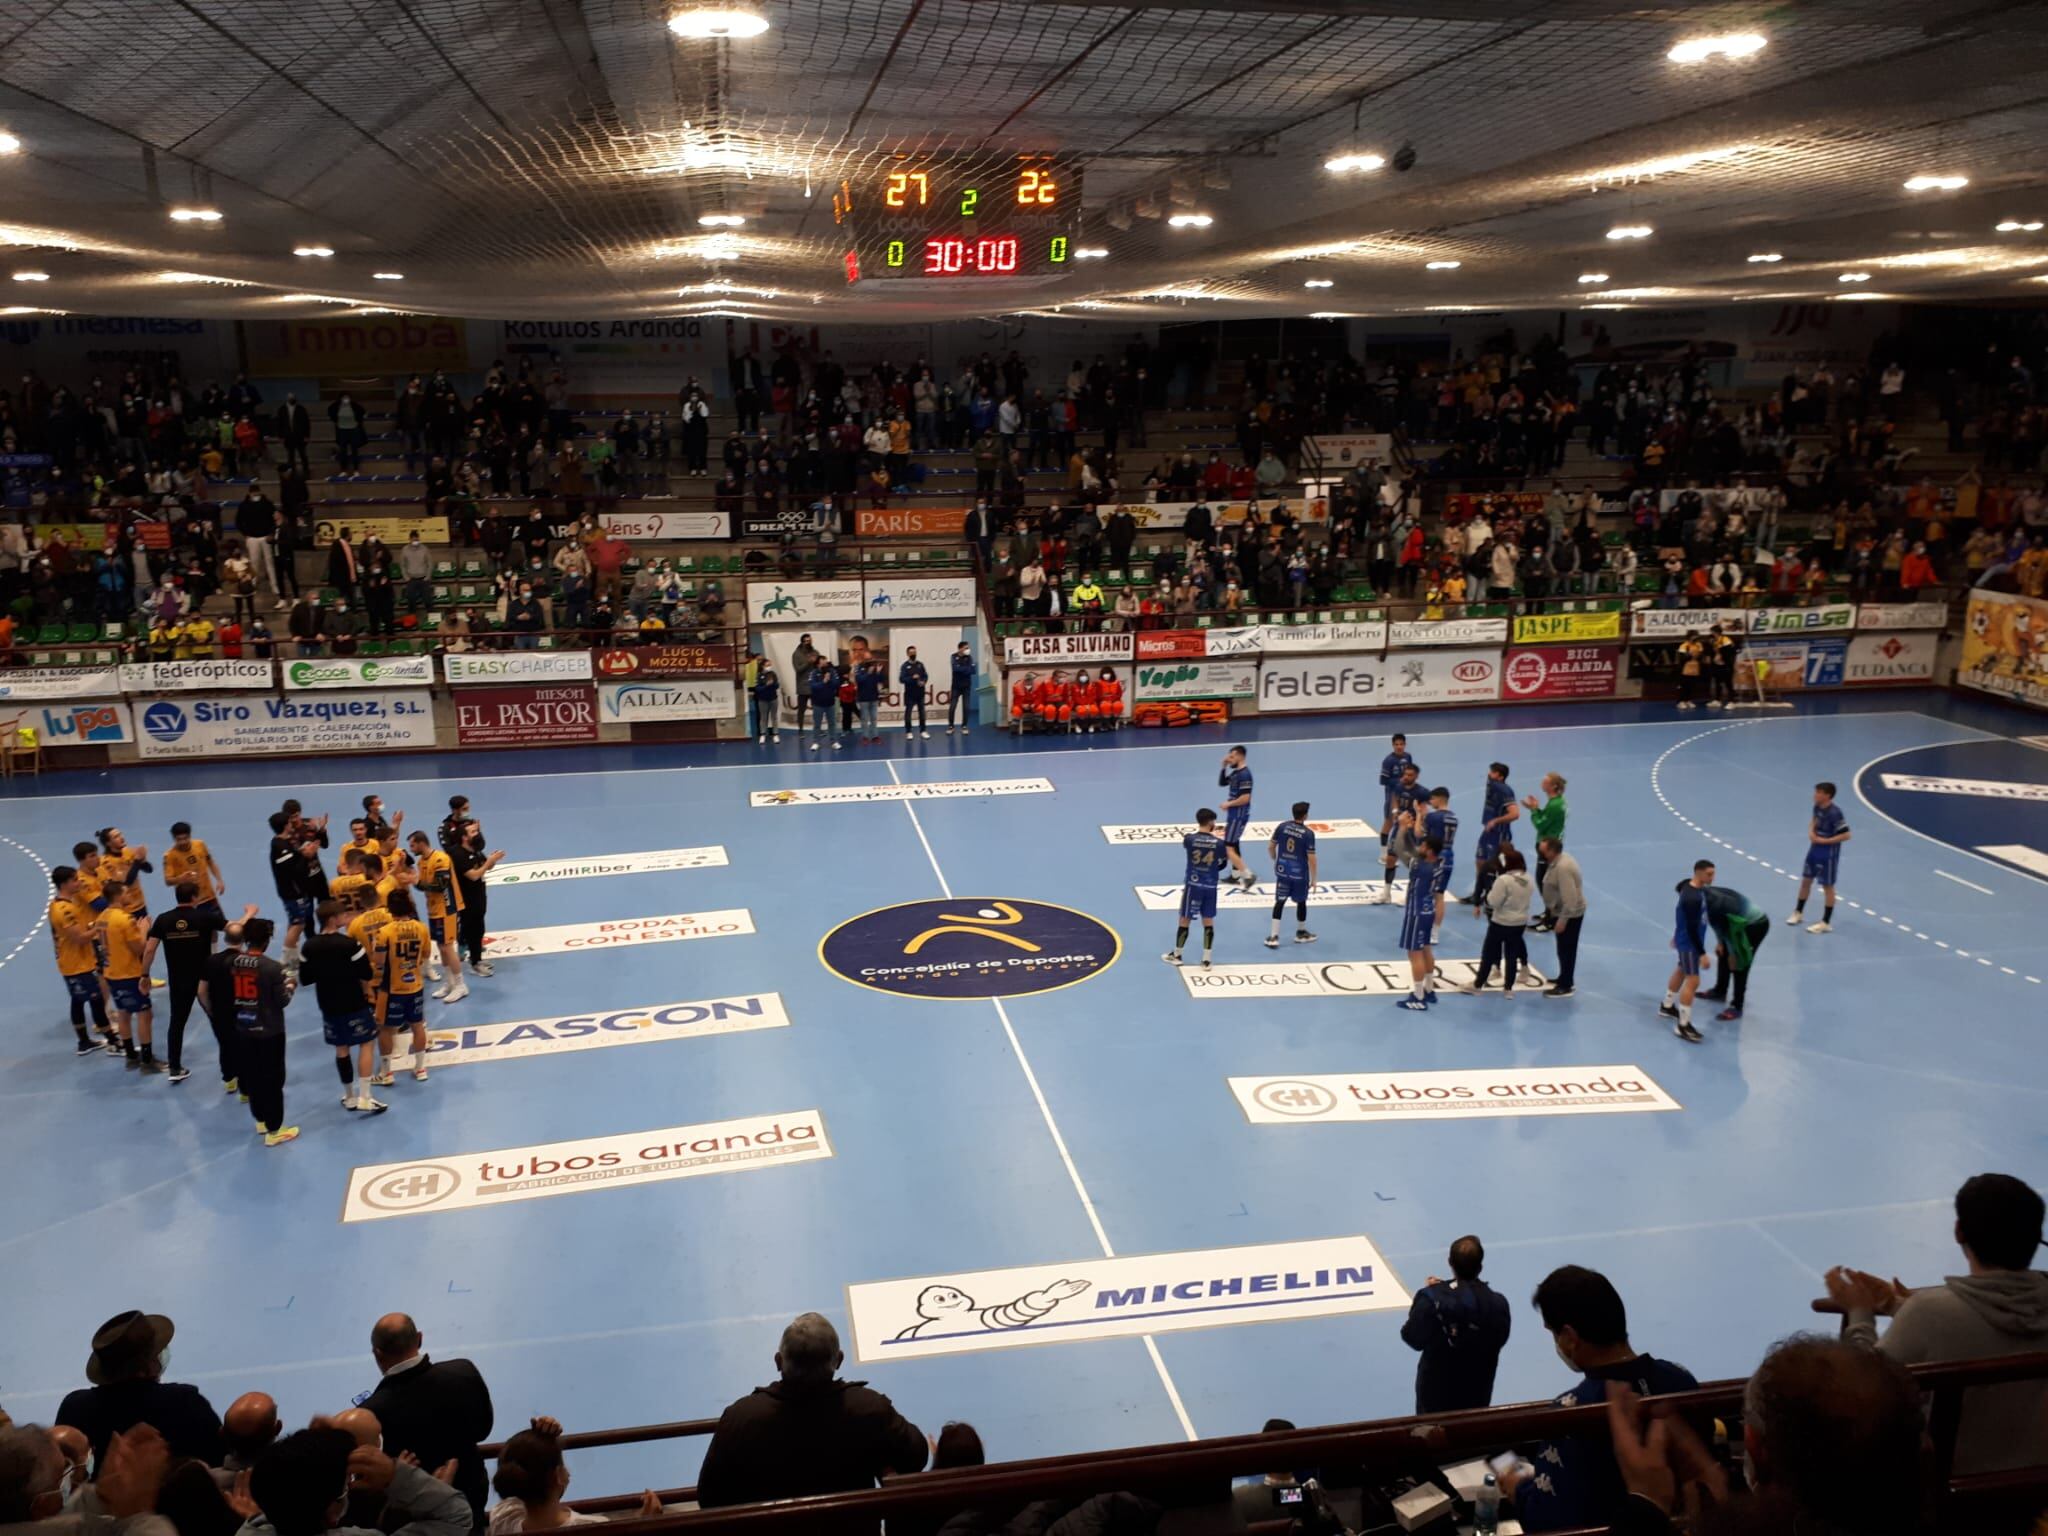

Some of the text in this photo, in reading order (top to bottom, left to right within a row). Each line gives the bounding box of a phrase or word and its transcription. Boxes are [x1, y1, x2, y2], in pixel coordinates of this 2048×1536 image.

[887, 173, 927, 206] 27
[961, 189, 977, 215] 2
[888, 241, 903, 266] 0
[925, 239, 1016, 272] 30:00
[1051, 237, 1066, 262] 0
[860, 511, 923, 532] PARÍS
[1516, 616, 1574, 641] JASPE
[1772, 609, 1850, 629] imesa
[1267, 627, 1381, 641] Carmelo Rodero
[662, 648, 705, 657] LUCIO
[1022, 635, 1131, 655] CASA SILVIANO
[1210, 637, 1261, 652] AJAX
[1567, 648, 1601, 660] BICI
[152, 660, 267, 679] federópticos
[468, 658, 588, 675] EASYCHARGER
[1460, 665, 1487, 678] KIA
[1549, 661, 1614, 673] ARANDA
[194, 702, 250, 722] Siro
[459, 701, 595, 728] EL PASTOR
[42, 706, 120, 740] lupa
[214, 735, 288, 746] MOBILIARIO
[293, 735, 308, 743] DE
[314, 733, 360, 742] COCINA
[376, 731, 411, 740] BAÑO
[1119, 826, 1197, 835] prado
[1286, 838, 1296, 853] 6
[1191, 850, 1215, 867] 34
[529, 863, 633, 880] MultiRiber
[600, 916, 696, 932] BODAS
[564, 923, 740, 947] CON ESTILO
[860, 954, 1095, 976] Concejalía de Deportes
[235, 974, 257, 999] 16
[1190, 972, 1312, 987] BODEGAS
[1347, 1077, 1646, 1100] tubos aranda
[477, 1124, 817, 1182] tubos aranda
[507, 1145, 794, 1191] FABRICACIÓN DE TUBOS Y PERFILES
[1094, 1265, 1374, 1310] MICHELIN
